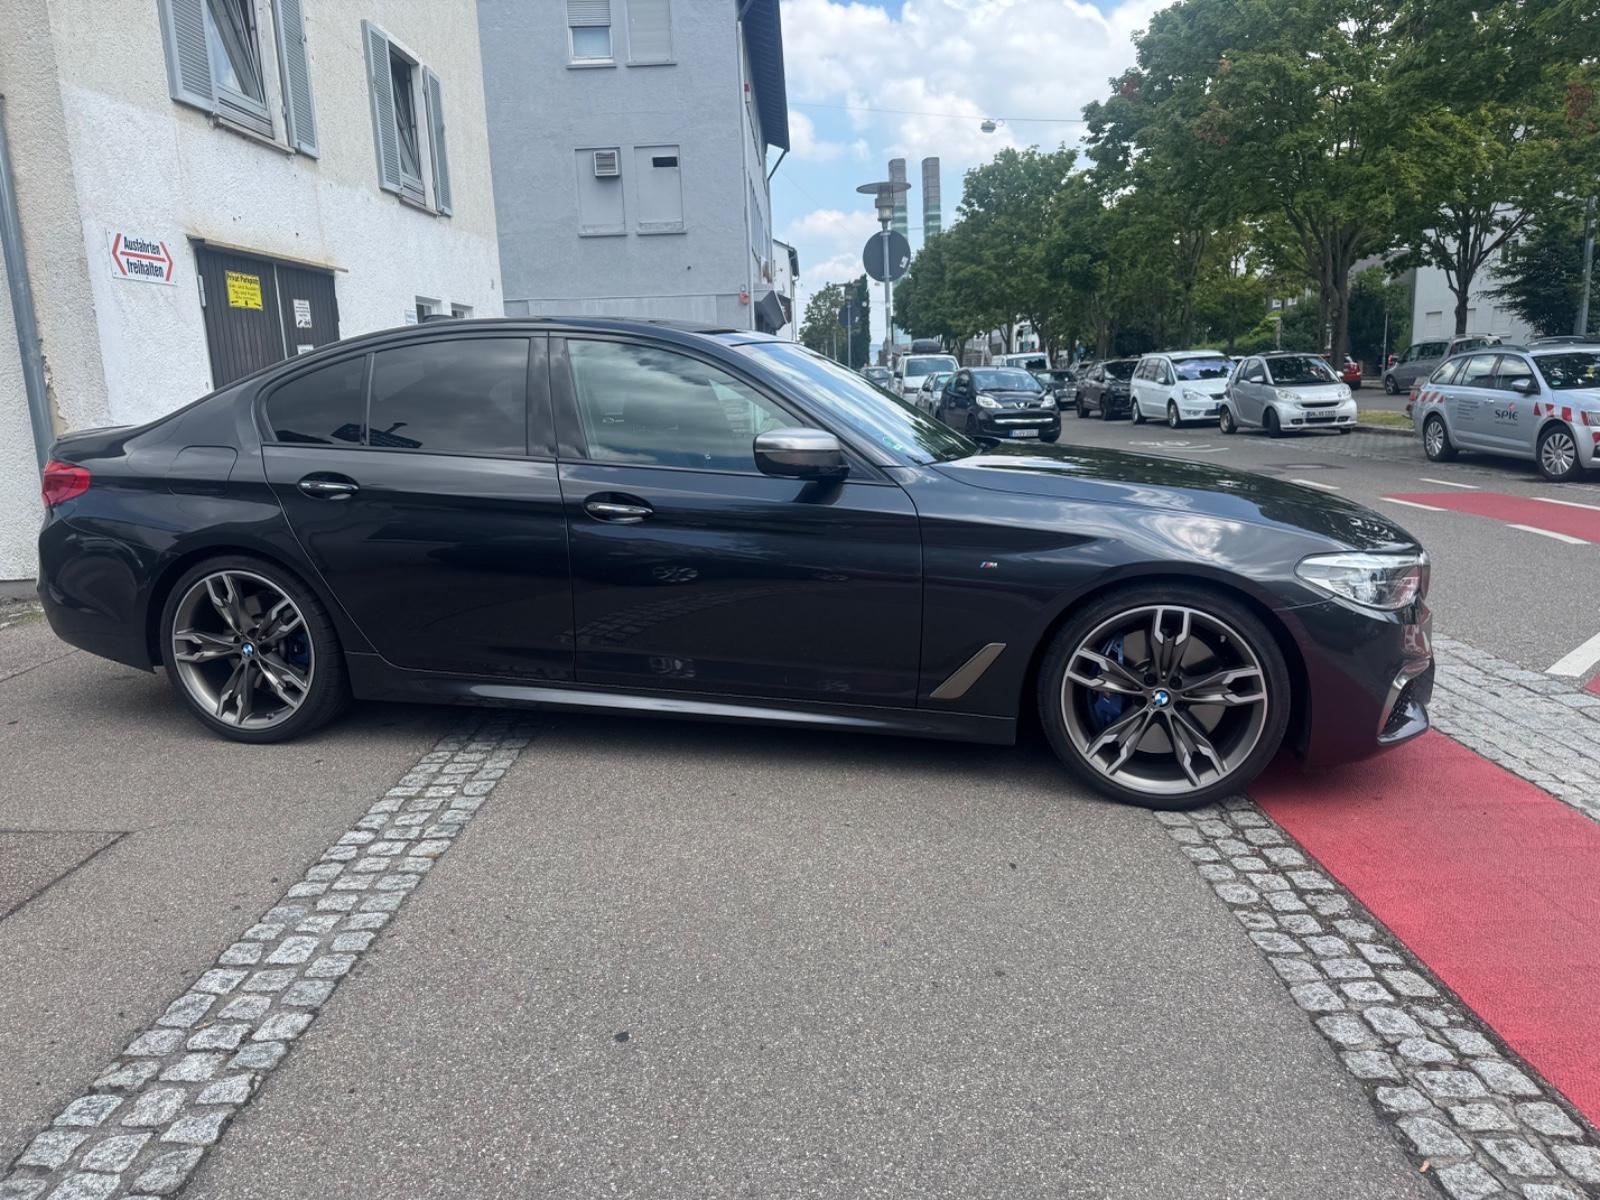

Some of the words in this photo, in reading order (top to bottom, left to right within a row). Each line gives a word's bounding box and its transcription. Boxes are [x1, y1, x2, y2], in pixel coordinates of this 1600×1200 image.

[123, 236, 161, 256] Ausfahrten
[126, 258, 164, 278] freihalten
[1495, 409, 1519, 421] SPIE
